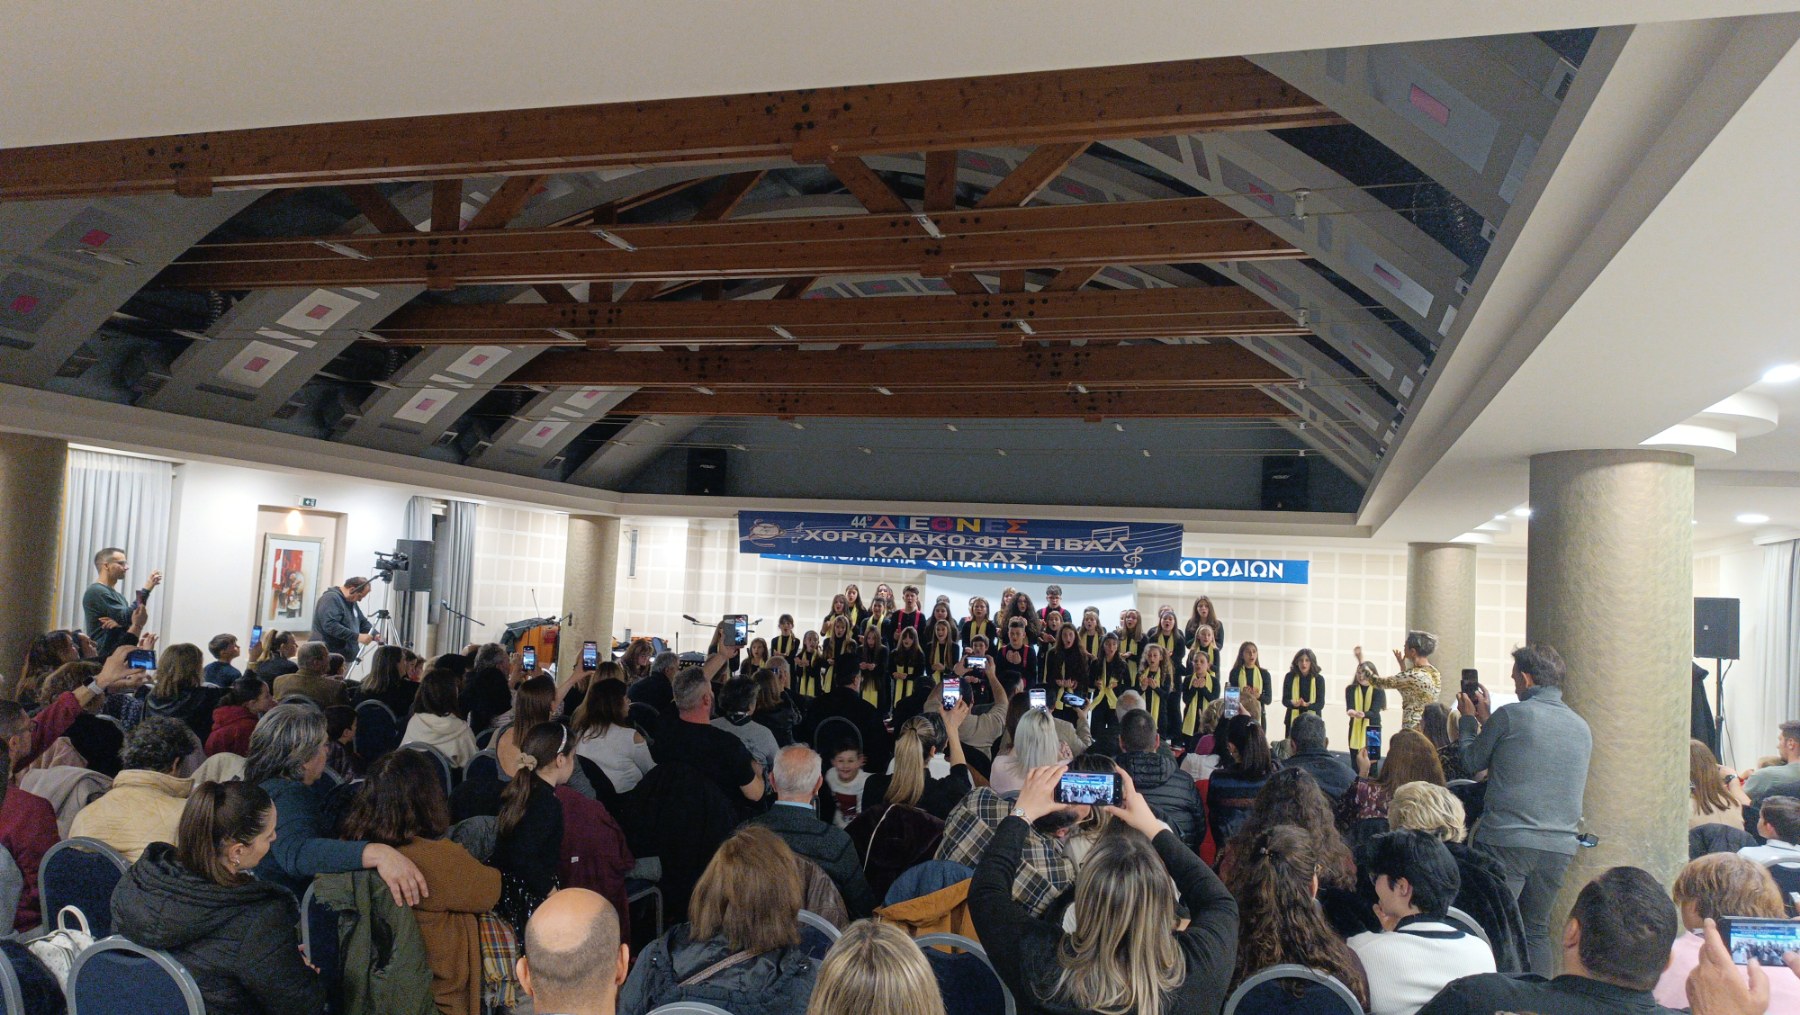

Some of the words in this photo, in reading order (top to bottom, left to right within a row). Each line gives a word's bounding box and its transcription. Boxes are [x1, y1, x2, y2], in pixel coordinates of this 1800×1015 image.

[804, 529, 966, 547] ΧΟΡΩΔΙΑΚΟ
[974, 535, 1130, 553] ΦΕΣΤΙΒΑΛ
[869, 545, 1027, 564] ΚΑΡΔΙΤΣΑΣ
